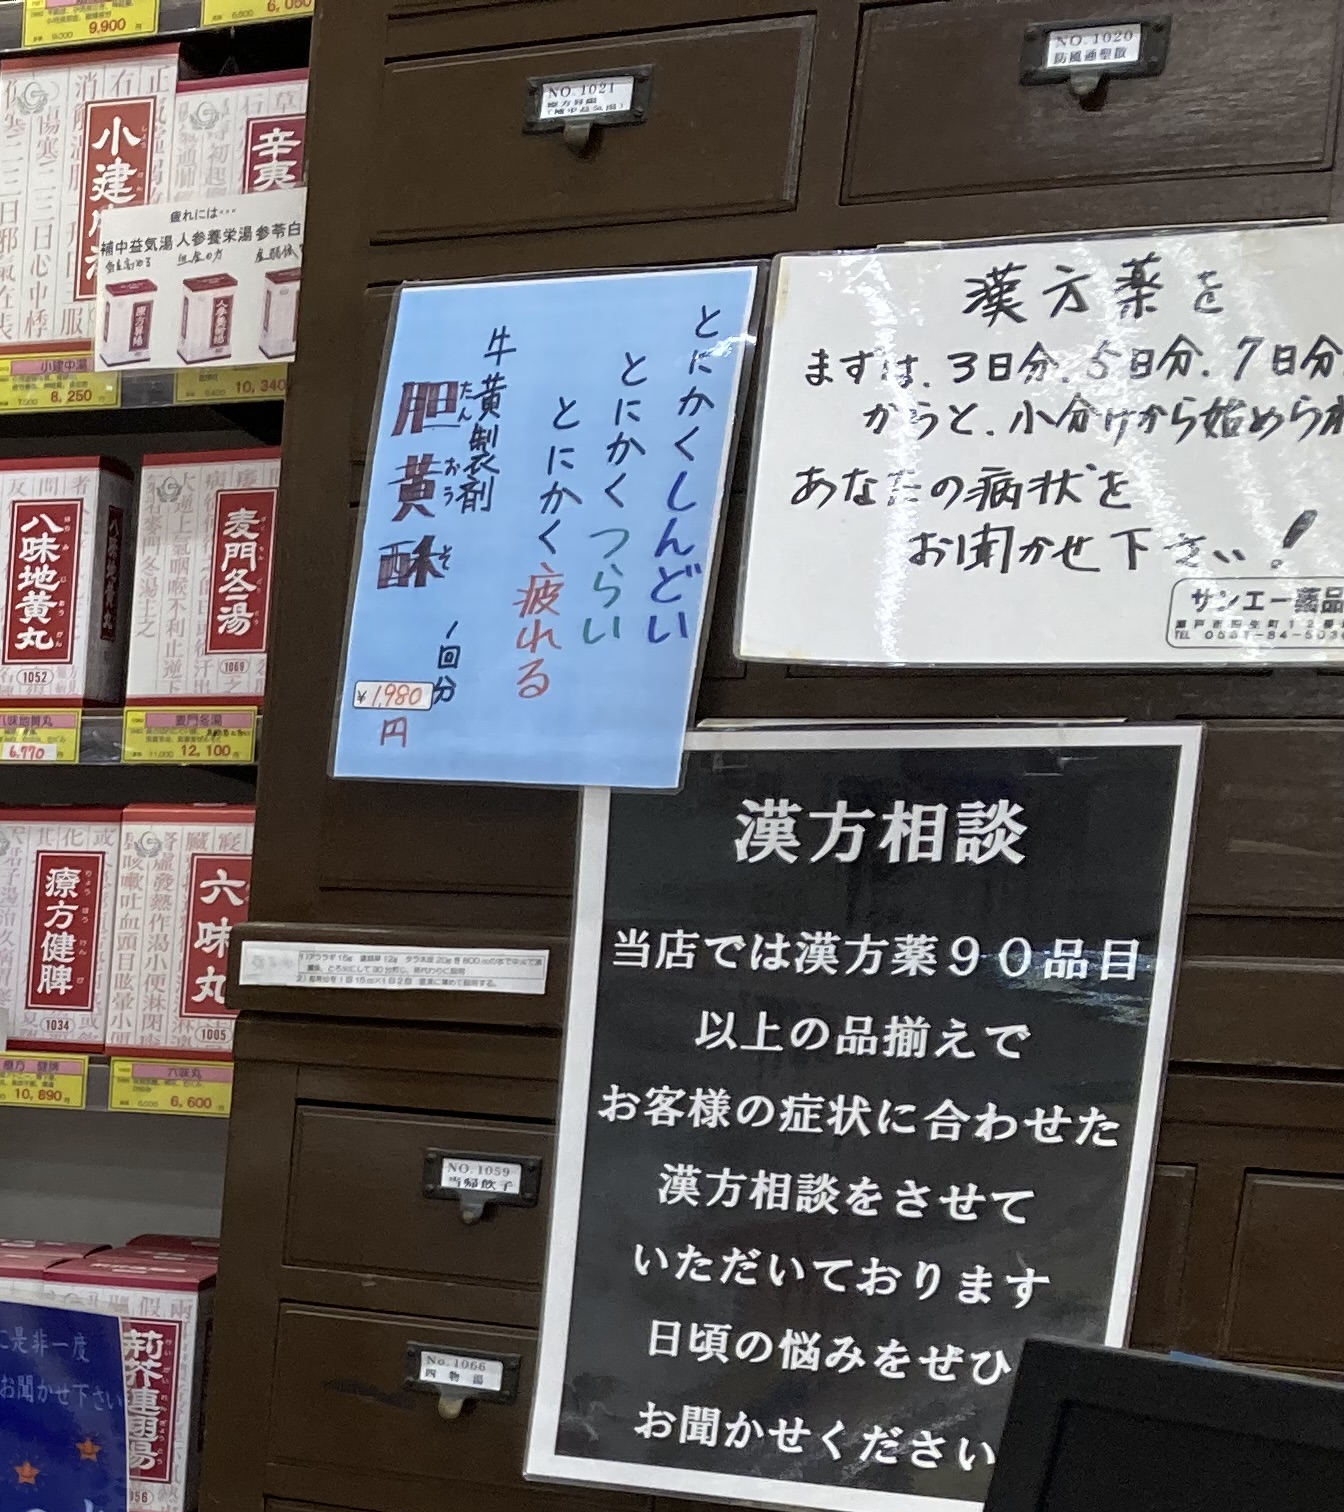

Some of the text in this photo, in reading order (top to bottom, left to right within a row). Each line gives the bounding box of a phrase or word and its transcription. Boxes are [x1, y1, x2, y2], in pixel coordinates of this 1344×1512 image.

[963, 252, 1224, 328] 漢方薬を
[583, 353, 647, 645] とにかくつらい
[648, 306, 721, 640] とにかくしんどい
[791, 464, 1132, 511] あなたの病状を
[517, 397, 583, 699] とにかく疲れる
[381, 719, 408, 748] 円
[734, 798, 1029, 866] 漢方相談
[694, 1010, 1031, 1060] 以上の品揃えで
[597, 1084, 1122, 1148] お客様の症状に合わせた
[658, 1163, 1037, 1225] 漢方相談をさせて
[633, 1243, 1051, 1310] いただいております
[648, 1321, 1011, 1387] 日頃の悩みをぜひ
[633, 1402, 997, 1472] お聞かせください
